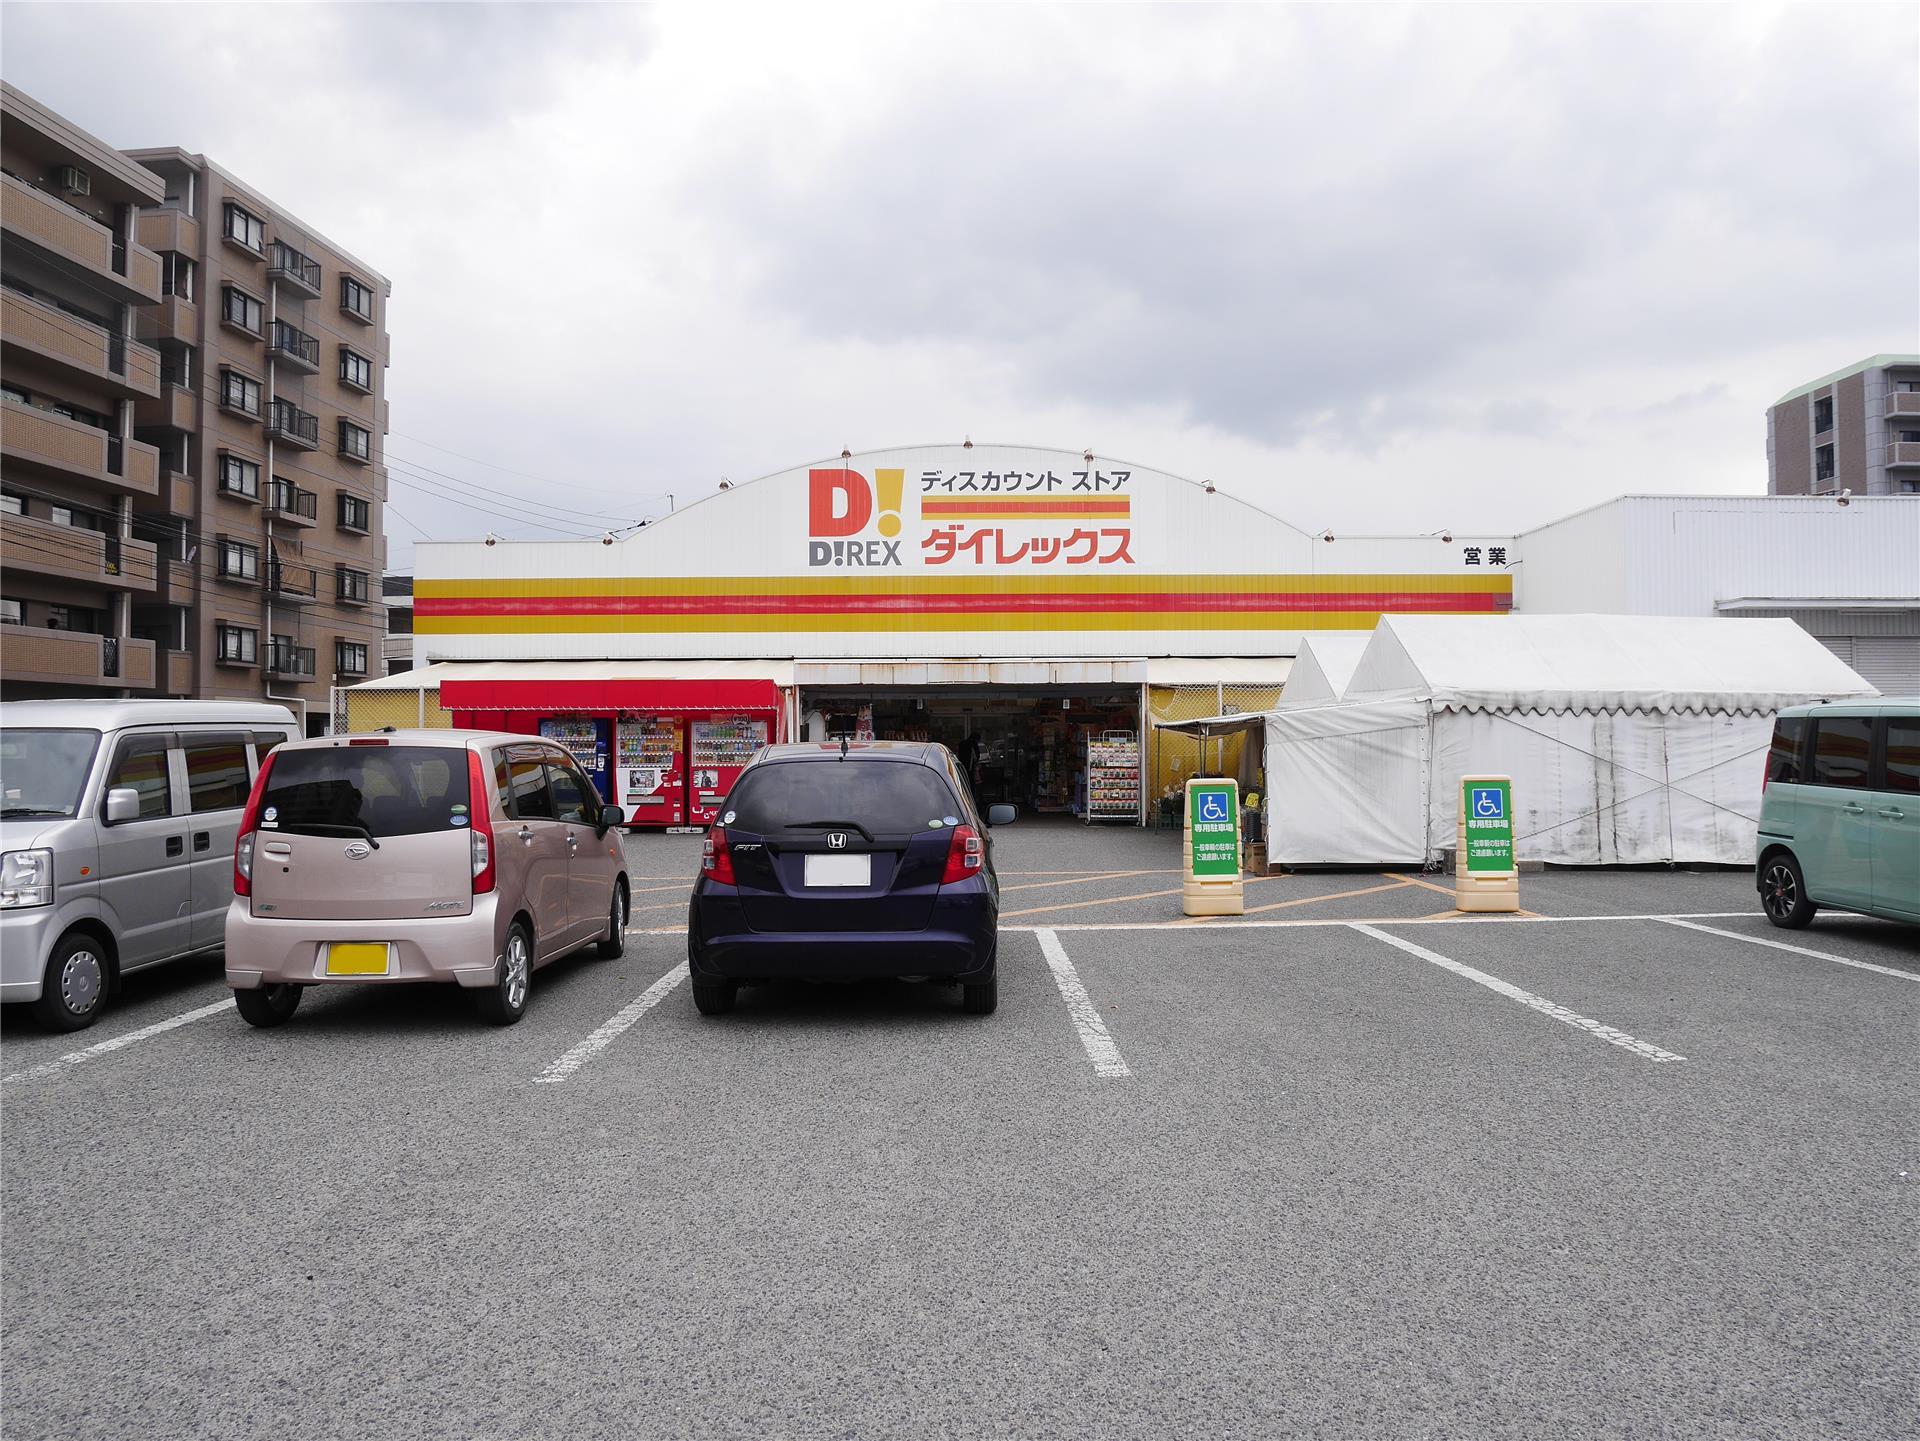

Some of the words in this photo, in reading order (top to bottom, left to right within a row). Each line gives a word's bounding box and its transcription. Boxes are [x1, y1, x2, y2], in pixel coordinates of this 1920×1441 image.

[921, 470, 1063, 492] ディスカウント
[1072, 470, 1132, 492] ストア
[921, 524, 1136, 565] ダイレックス
[1463, 546, 1507, 566] 営業
[1194, 823, 1234, 833] 専用駐車場
[1468, 819, 1509, 829] 専用駐車場
